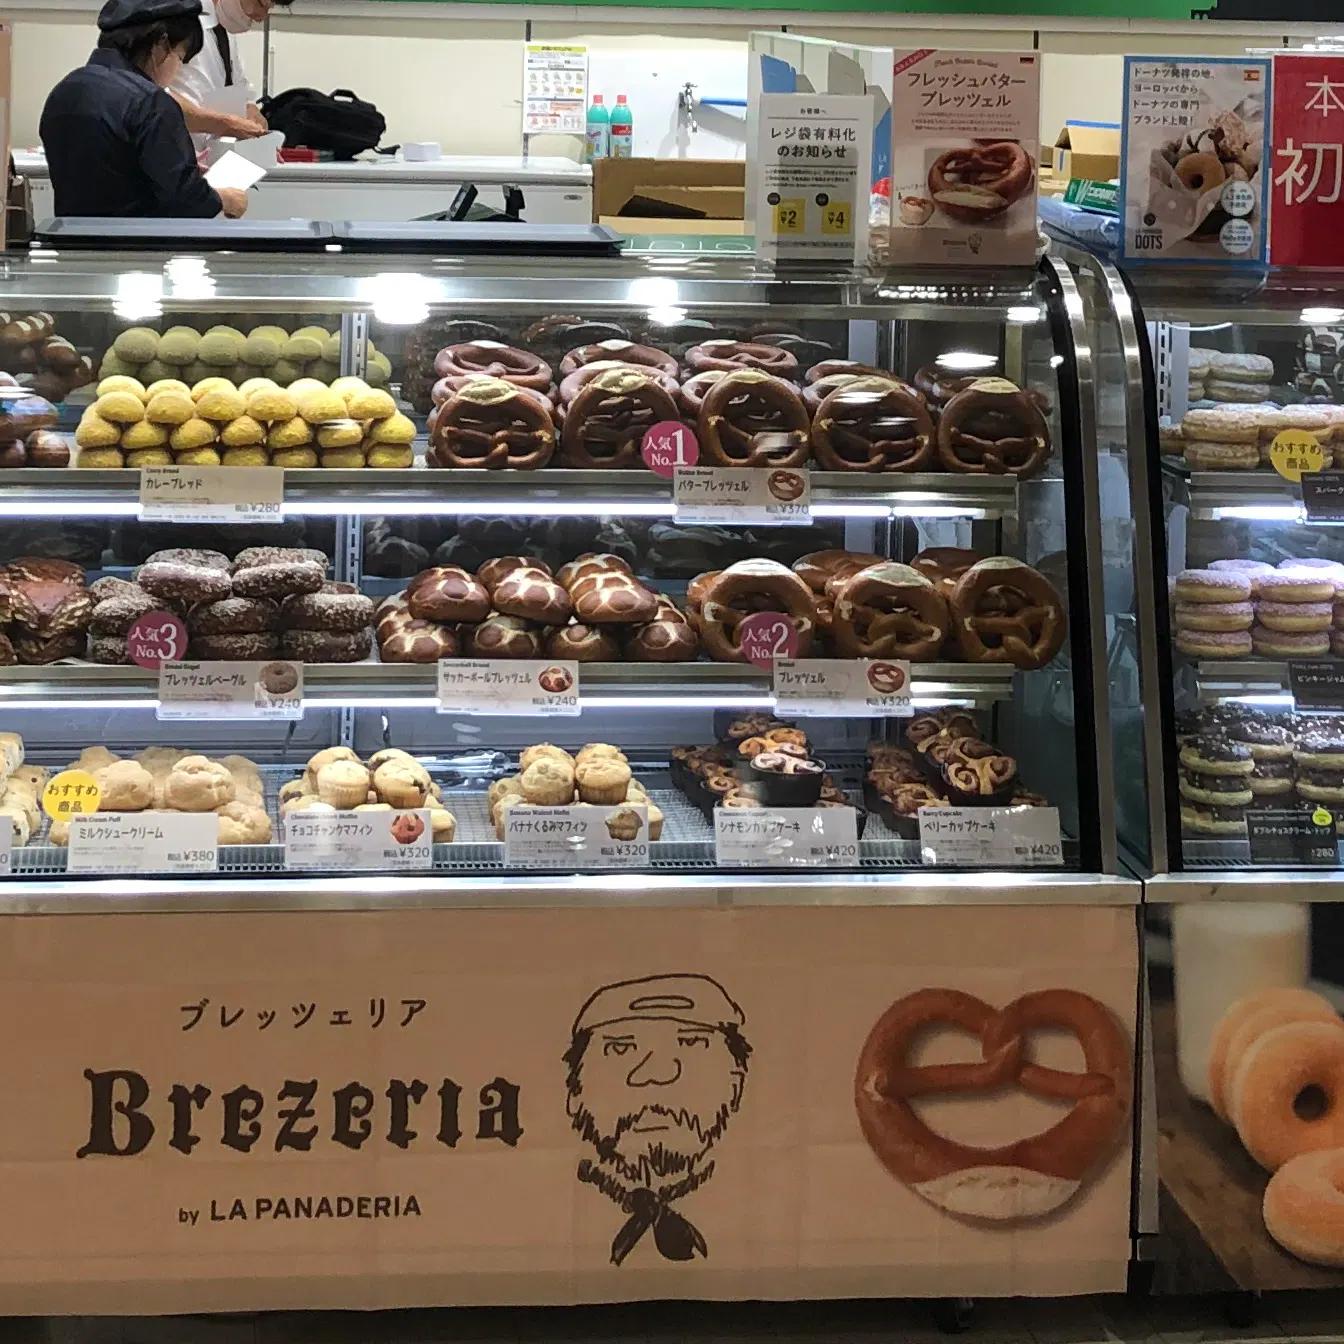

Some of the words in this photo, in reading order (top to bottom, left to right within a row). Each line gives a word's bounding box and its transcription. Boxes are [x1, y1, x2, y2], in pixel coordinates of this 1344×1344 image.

[908, 71, 1027, 89] フレッシュバター
[921, 90, 1012, 109] ブレッツェル
[770, 125, 857, 143] レジ袋有料化
[776, 143, 848, 160] のお知らせ
[1135, 234, 1163, 250] DOTS
[643, 435, 673, 452] 人気
[1272, 441, 1321, 456] おすすめ
[1286, 457, 1310, 470] 商品
[130, 628, 159, 641] 人気
[743, 628, 772, 642] 人気
[547, 695, 577, 706] ¥240
[880, 696, 910, 707] ¥320
[47, 783, 99, 797] おすすめ
[57, 798, 83, 813] 商品
[79, 827, 164, 839] ミルクシュークリーム
[509, 821, 588, 833] バナナくるみマフィン
[924, 821, 996, 833] ベリーカップケーキ
[183, 850, 214, 862] ¥380
[399, 847, 430, 858] ¥320
[616, 844, 647, 856] ¥320
[826, 844, 856, 856] ¥420
[1030, 844, 1060, 855] ¥420
[179, 996, 427, 1031] ブレッツェリア
[76, 1067, 525, 1160] Brezeria
[178, 1206, 200, 1226] by
[210, 1198, 248, 1223] LA
[255, 1194, 422, 1220] PANADERIA
